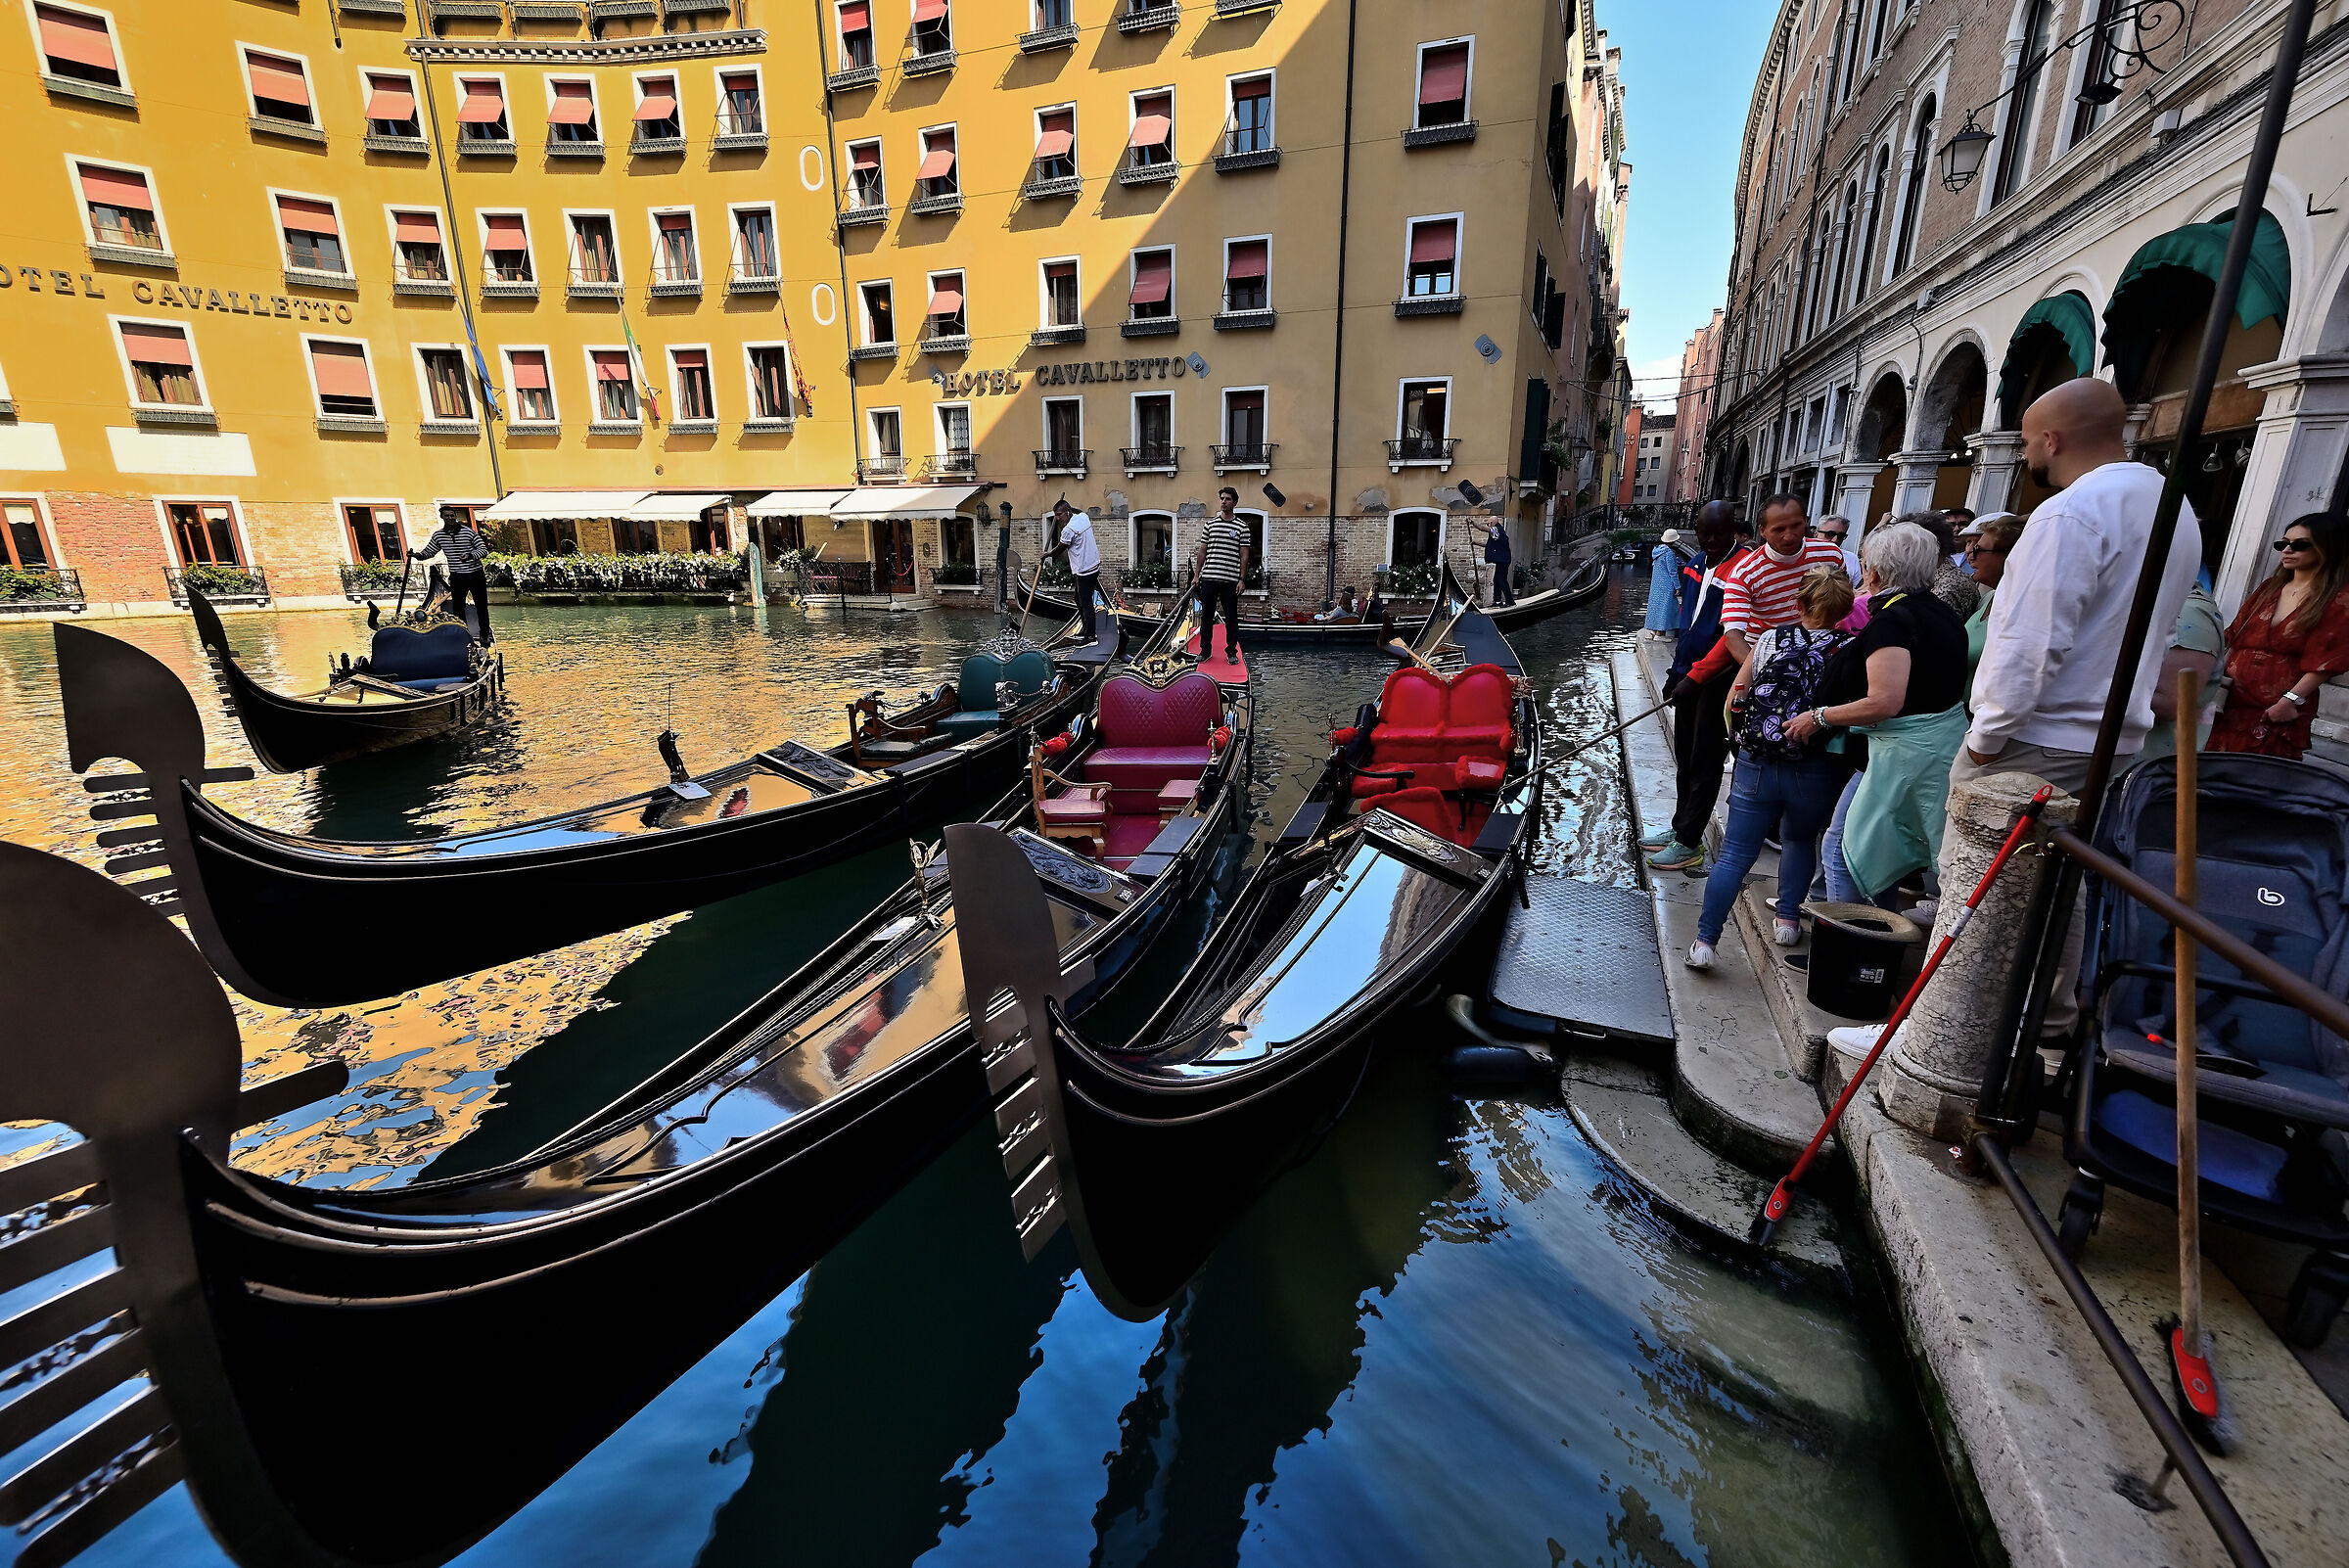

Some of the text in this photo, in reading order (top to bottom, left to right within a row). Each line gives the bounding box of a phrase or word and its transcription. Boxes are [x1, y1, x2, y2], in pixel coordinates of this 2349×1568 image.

[132, 280, 353, 324] CAVALLETTO
[945, 356, 1186, 392] HOTEL CAVALLETTO
